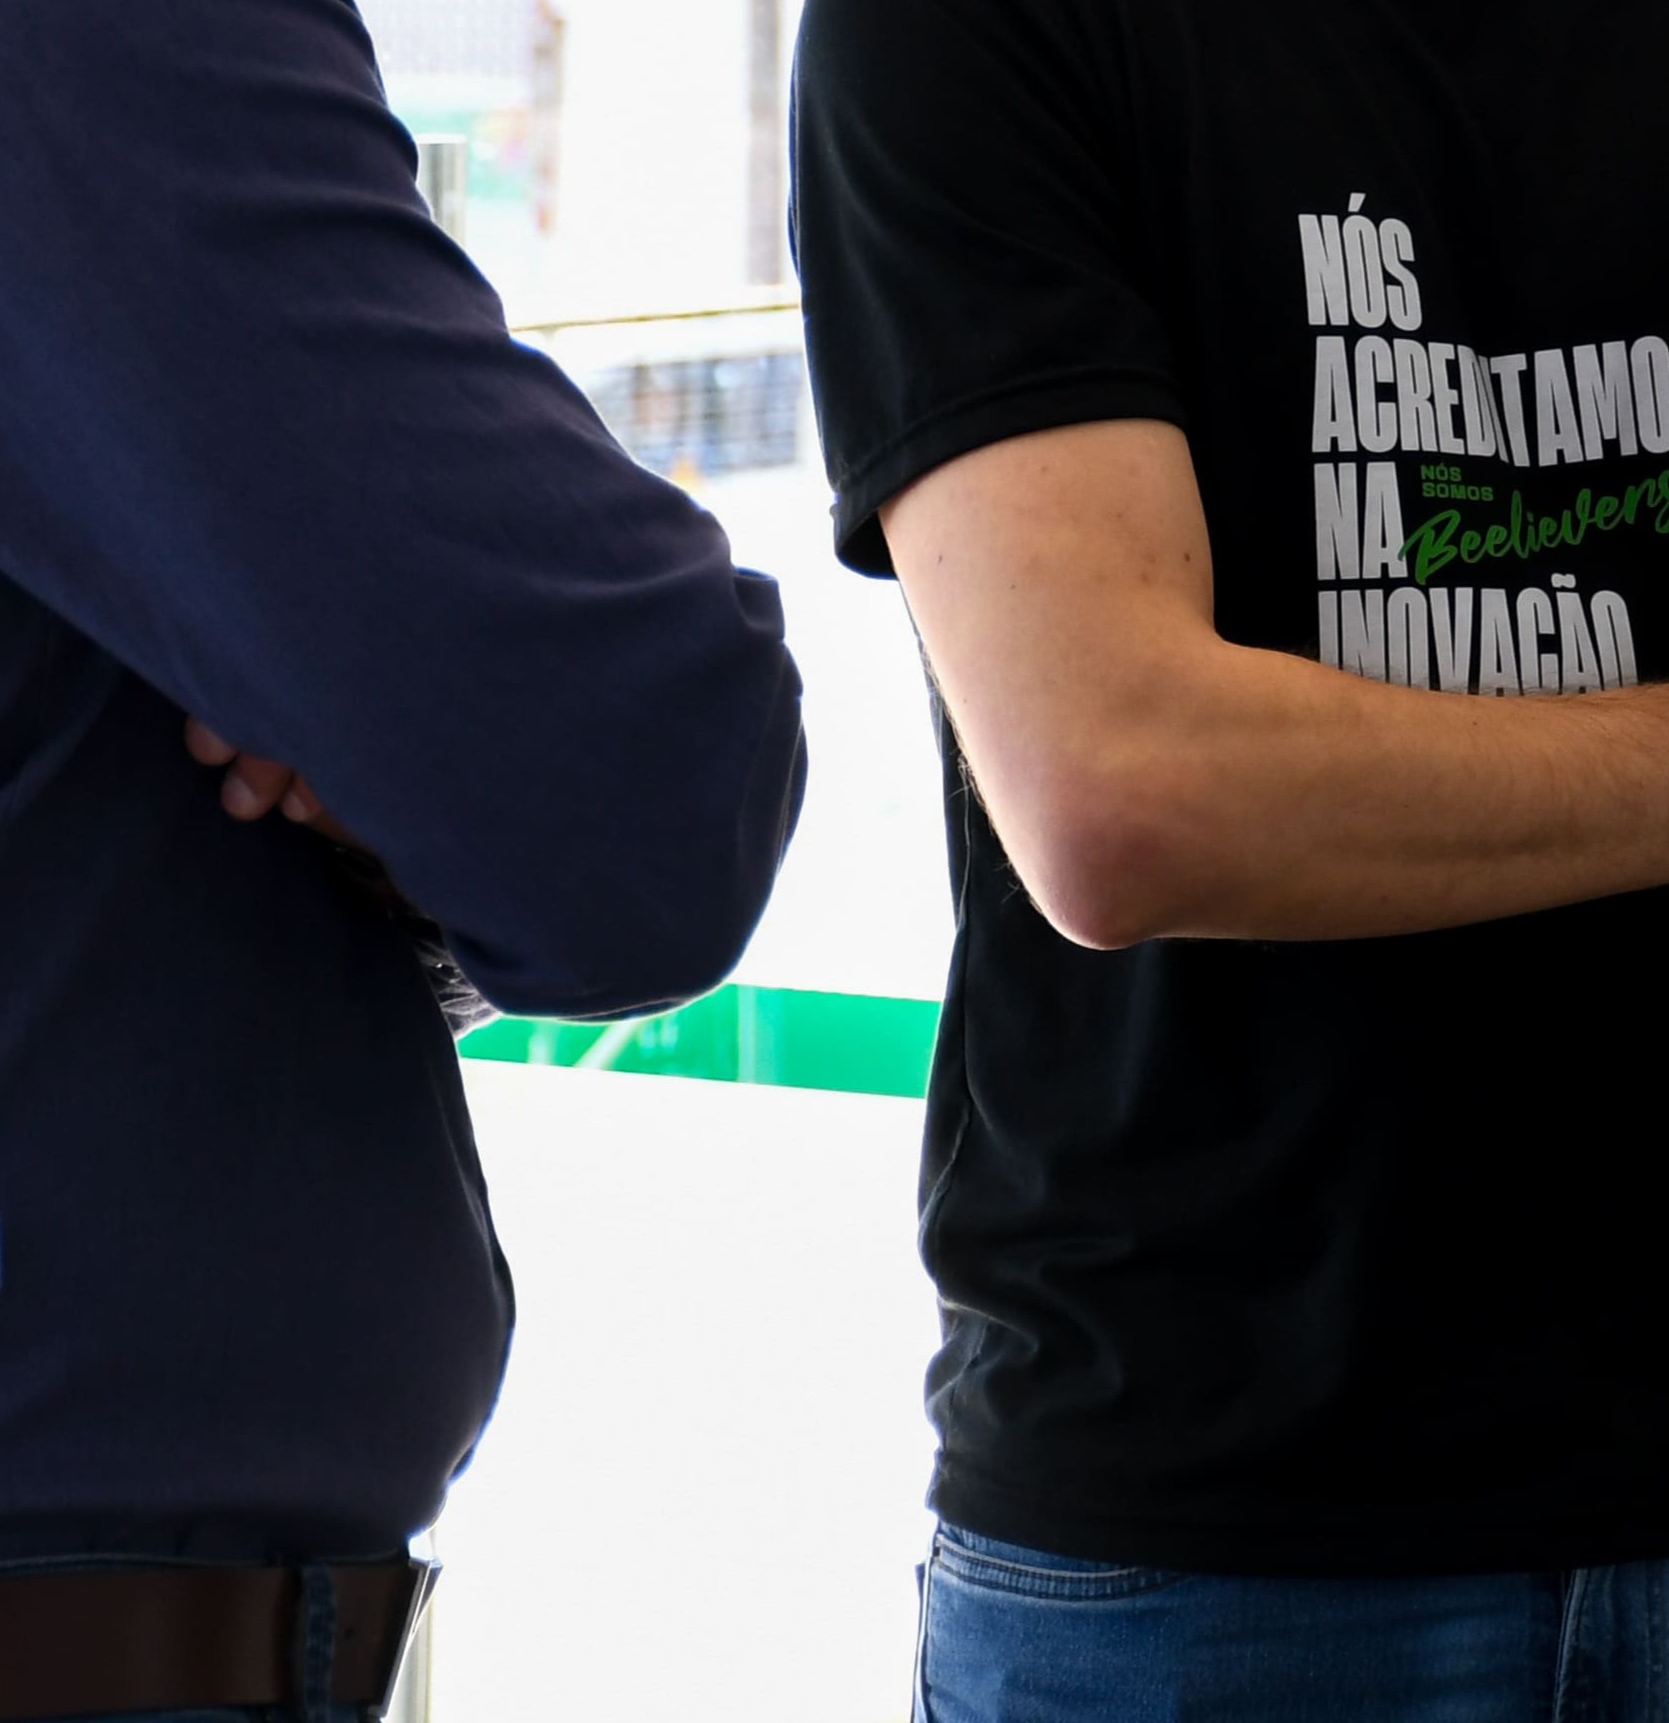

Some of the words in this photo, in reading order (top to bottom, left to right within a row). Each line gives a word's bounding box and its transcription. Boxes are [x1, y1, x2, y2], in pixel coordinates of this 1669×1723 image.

[1298, 192, 1422, 331] NÓS
[1420, 462, 1462, 482] NÓS
[1421, 482, 1494, 502] SOMOS
[1313, 461, 1409, 581] NA
